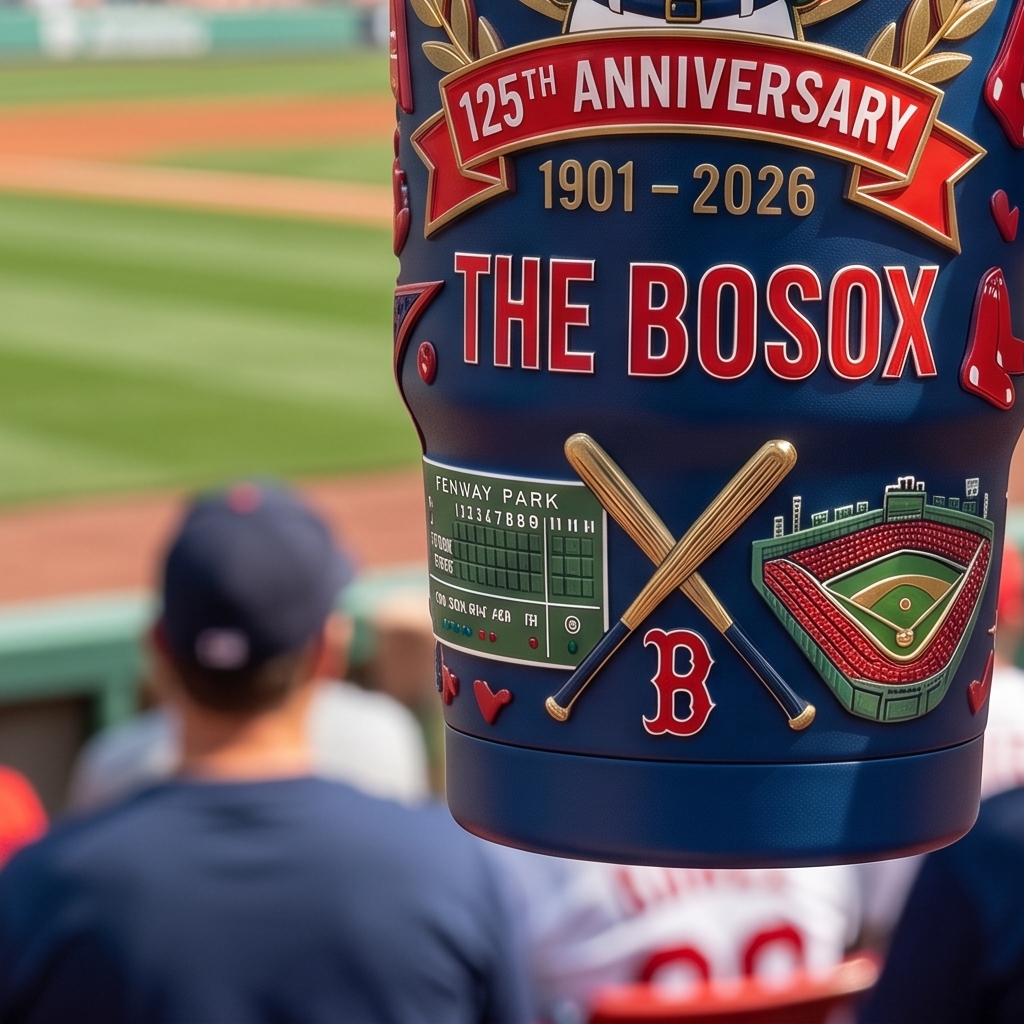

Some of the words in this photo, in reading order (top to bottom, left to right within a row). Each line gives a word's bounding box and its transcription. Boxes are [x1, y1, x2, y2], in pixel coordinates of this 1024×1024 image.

[573, 55, 918, 151] ANNIVERSARY
[538, 159, 634, 212] 1901
[693, 163, 816, 216] 2026
[453, 251, 596, 374] THE
[627, 262, 940, 381] BOSOX
[435, 475, 492, 501] FENWAY
[502, 488, 559, 510] PARK
[642, 628, 717, 737] B
